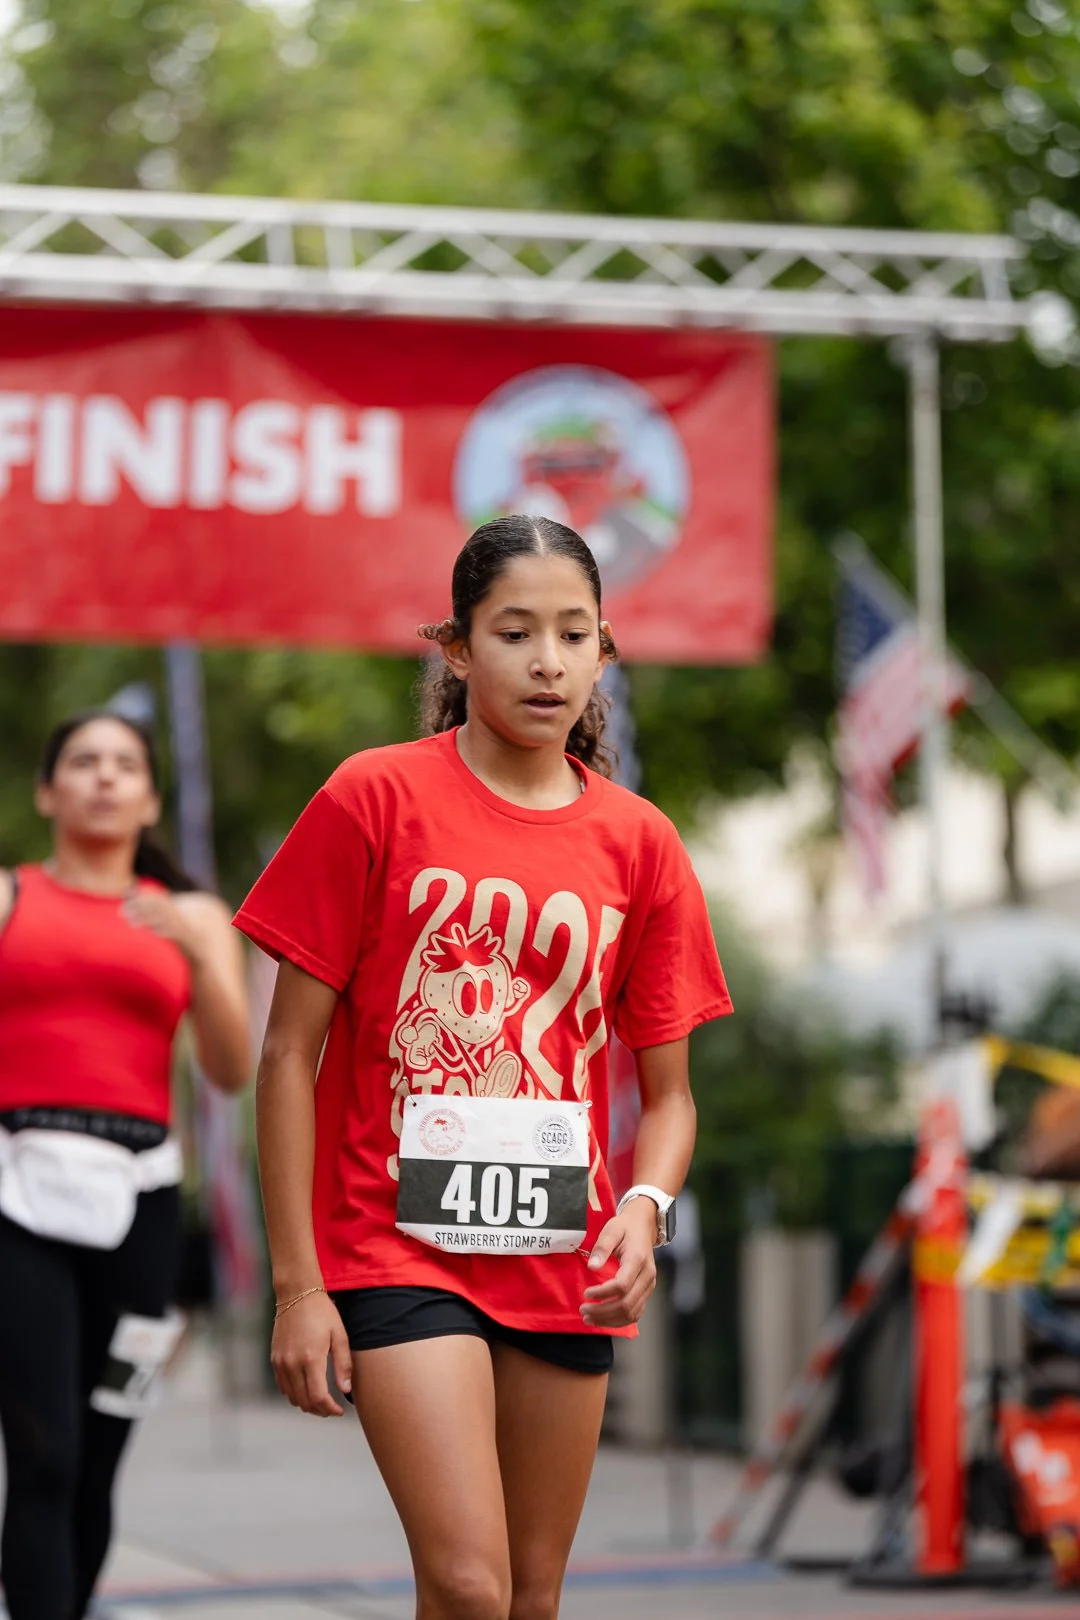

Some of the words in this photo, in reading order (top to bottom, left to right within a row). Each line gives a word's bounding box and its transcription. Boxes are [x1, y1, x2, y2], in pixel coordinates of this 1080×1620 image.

[0, 391, 402, 518] FINISH
[541, 1131, 568, 1145] SCAGG
[440, 1163, 550, 1227] 405
[434, 1232, 501, 1247] STRAWBERRY
[503, 1235, 537, 1248] STOMP
[538, 1236, 552, 1249] 5K
